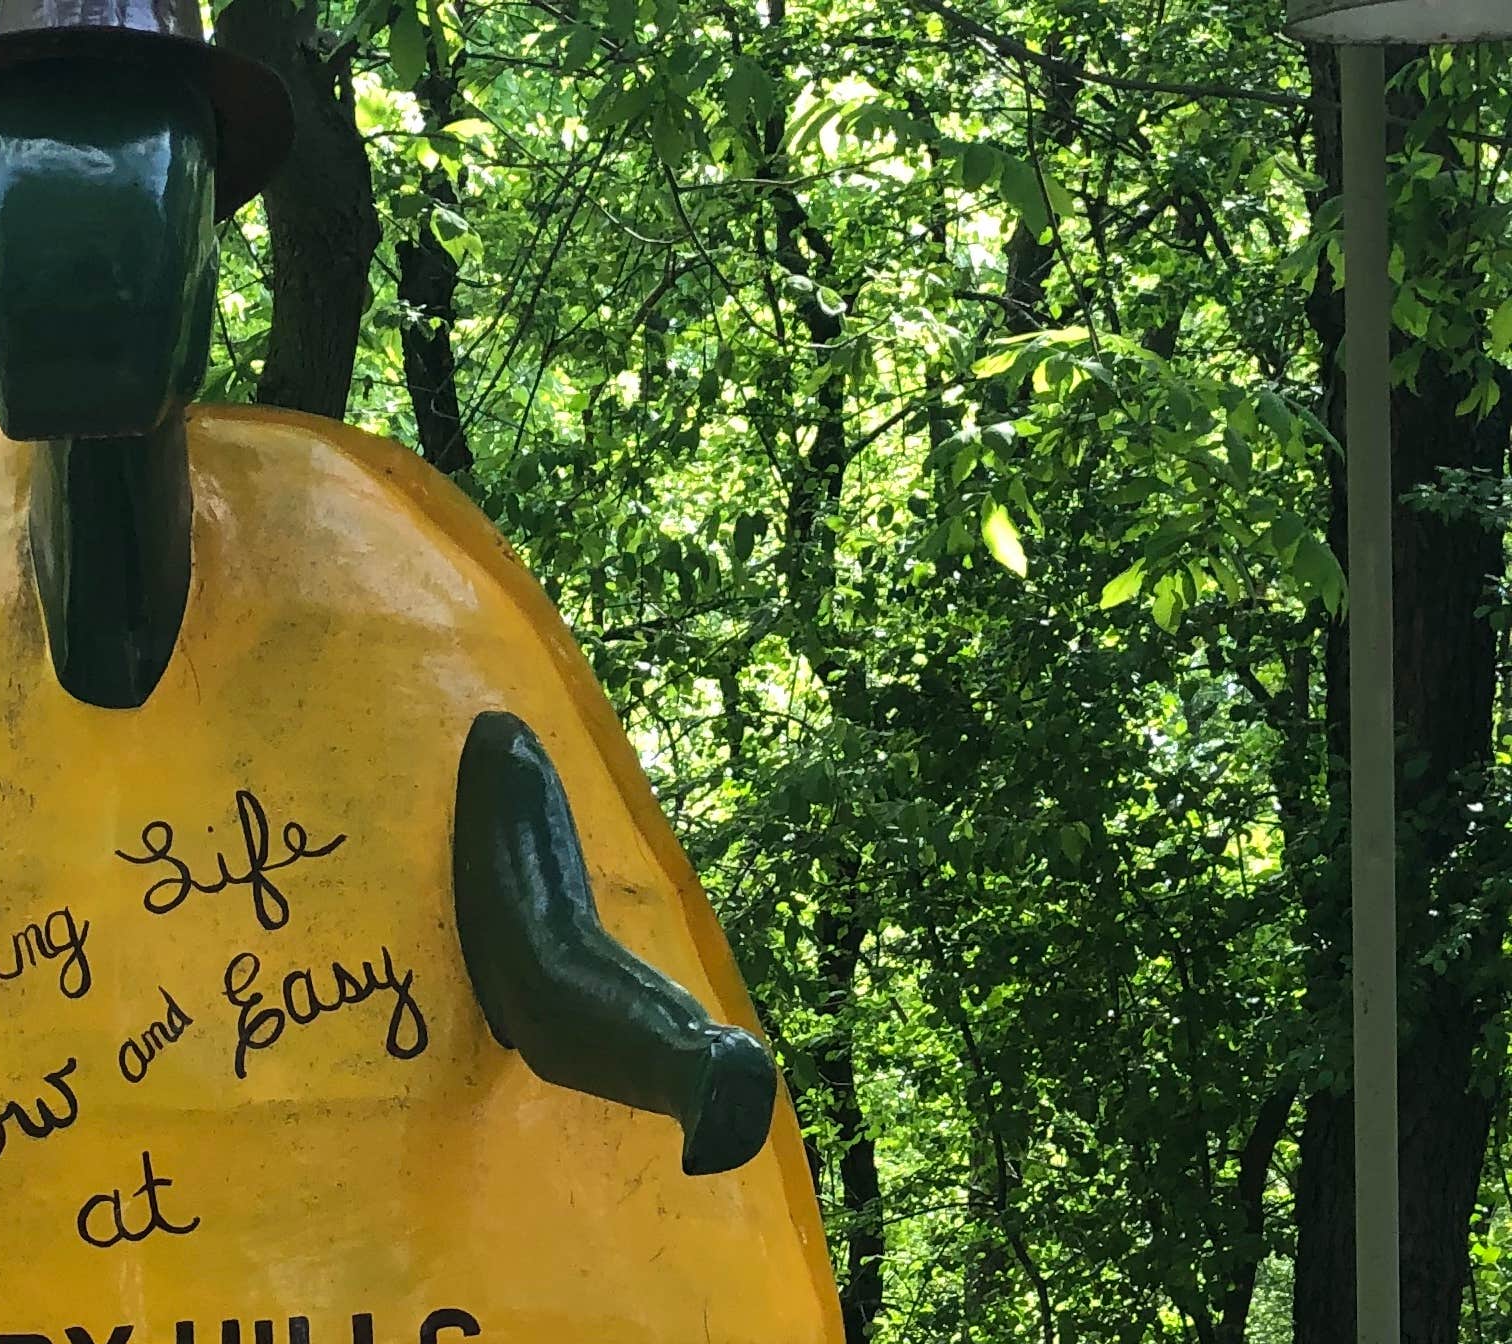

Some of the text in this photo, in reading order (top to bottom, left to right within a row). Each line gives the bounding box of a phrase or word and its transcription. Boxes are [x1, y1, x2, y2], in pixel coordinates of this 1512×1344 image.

[115, 790, 347, 931] Life
[118, 986, 194, 1083] and
[223, 947, 429, 1079] Easy
[77, 1151, 201, 1248] at
